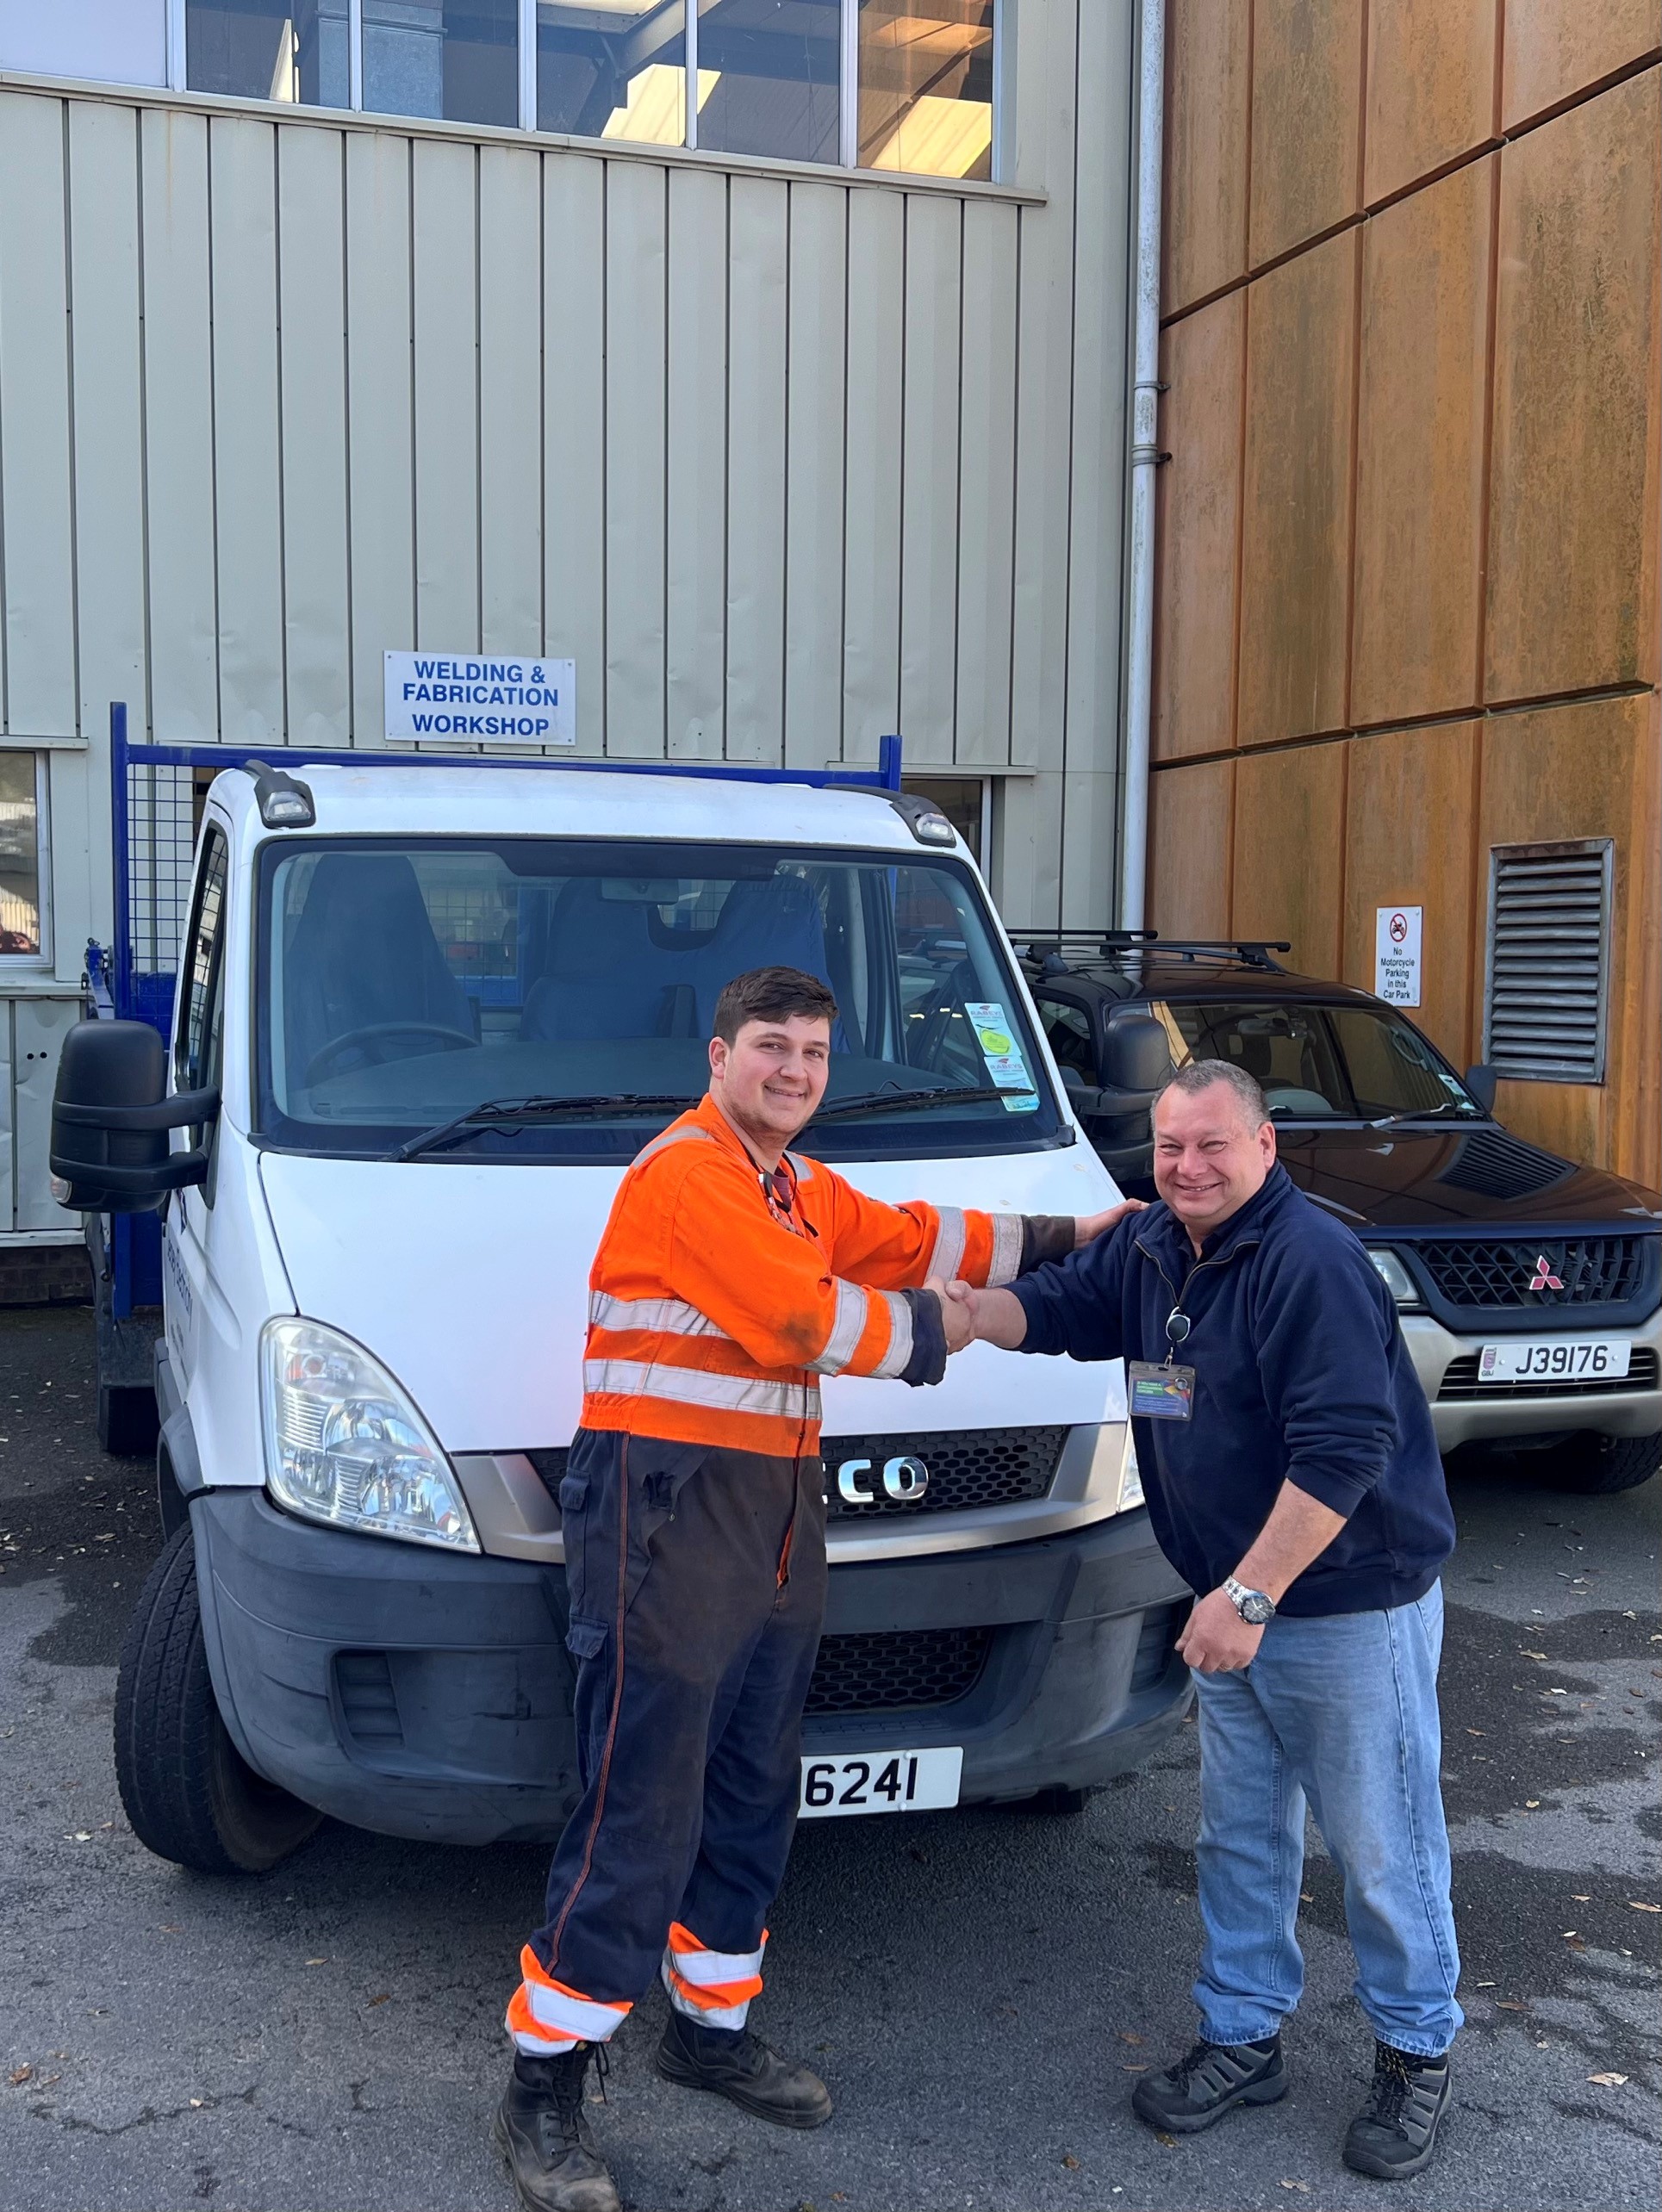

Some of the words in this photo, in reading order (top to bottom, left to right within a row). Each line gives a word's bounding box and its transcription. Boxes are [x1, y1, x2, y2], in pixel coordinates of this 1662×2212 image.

[414, 661, 523, 683] WELDING
[531, 666, 545, 684] &
[403, 683, 558, 706] FABRICATION
[412, 714, 549, 736] WORKSHOP
[1393, 947, 1403, 956] No
[1380, 958, 1416, 968] Motorcycle
[1385, 968, 1410, 979] Parking
[1388, 979, 1394, 988] in
[1395, 979, 1406, 988] this
[1383, 990, 1395, 999] Car
[1396, 990, 1410, 999] Park
[1515, 1345, 1609, 1374] J39176
[805, 1756, 918, 1807] 6241
